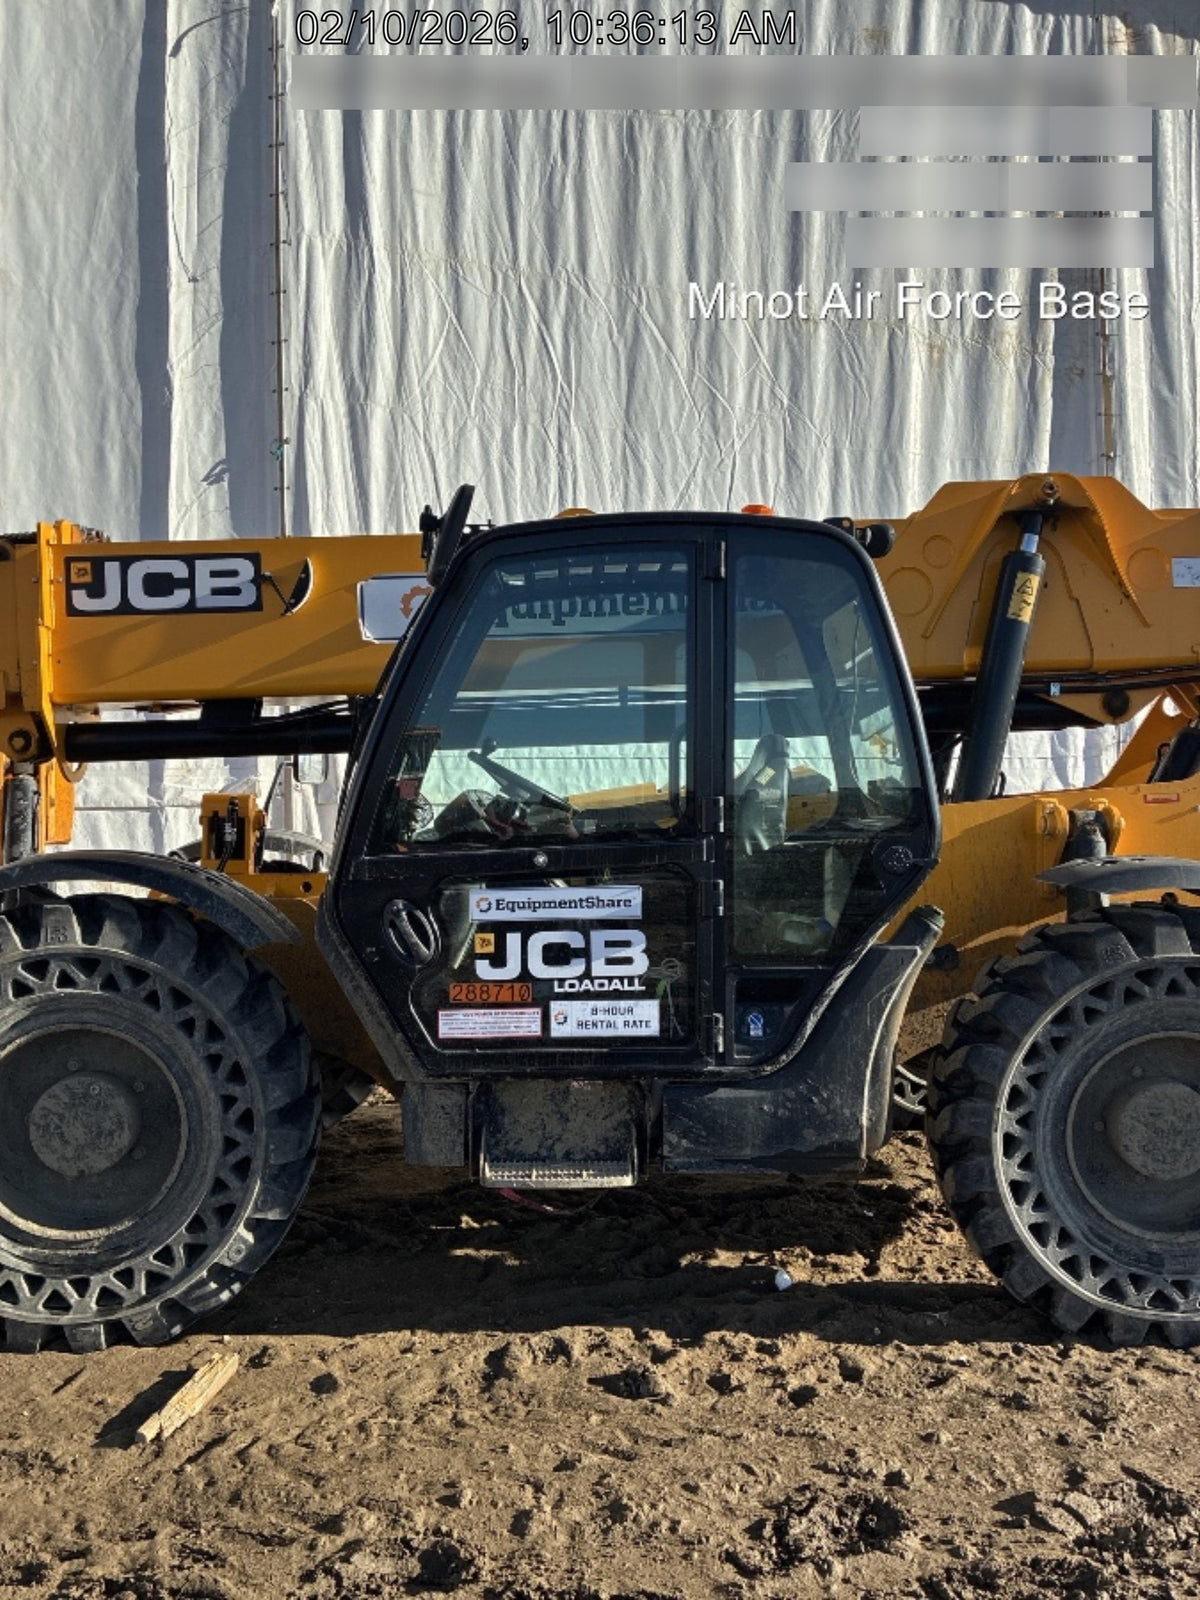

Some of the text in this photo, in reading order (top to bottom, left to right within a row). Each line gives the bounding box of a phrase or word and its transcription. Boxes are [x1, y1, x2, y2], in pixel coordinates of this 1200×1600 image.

[71, 557, 257, 611] JCB
[495, 896, 632, 913] EquipmentShare
[475, 929, 650, 980] JCB
[452, 984, 531, 1002] 288710
[554, 977, 646, 993] LOADALL
[577, 1019, 652, 1030] RENTAL RATE
